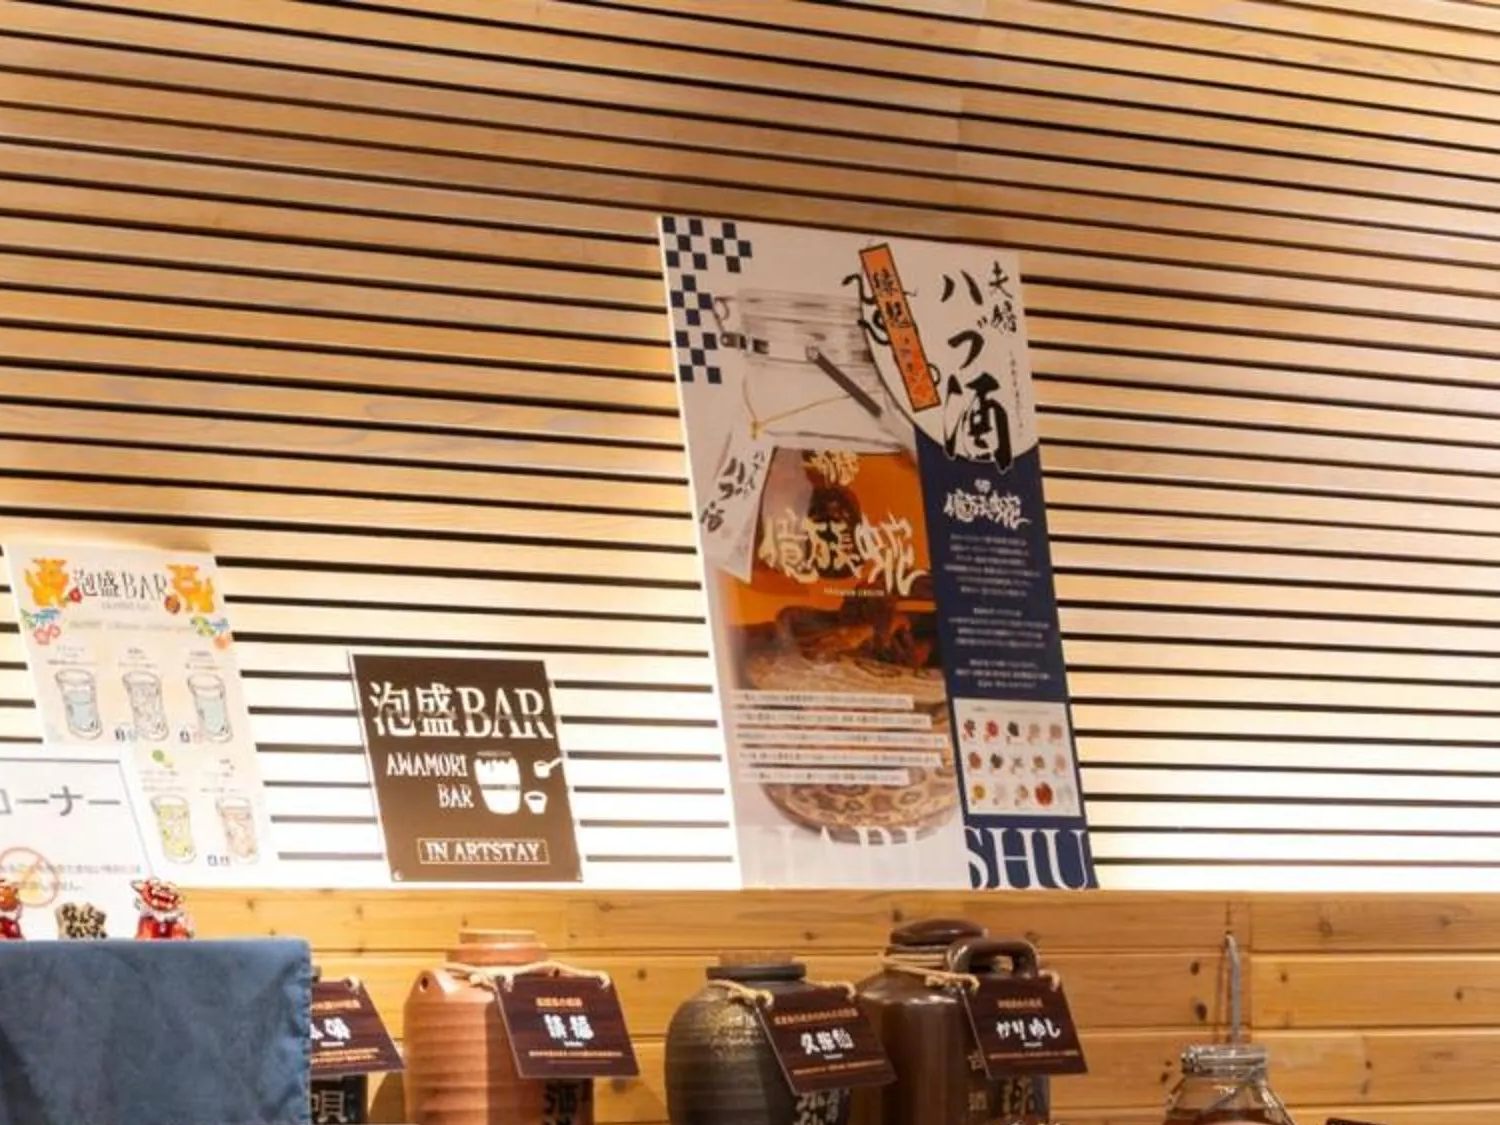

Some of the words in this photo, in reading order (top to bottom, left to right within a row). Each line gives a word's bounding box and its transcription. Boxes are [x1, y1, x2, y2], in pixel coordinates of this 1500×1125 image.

[940, 268, 1016, 475] ハブ酒
[72, 566, 168, 600] 泡盛BAR
[369, 681, 555, 739] 泡盛BAR
[386, 752, 469, 777] AWAMORI
[437, 783, 476, 809] BAR
[424, 841, 449, 861] IN
[453, 842, 541, 862] ARTSTAY
[995, 1017, 1061, 1041] かりゆし
